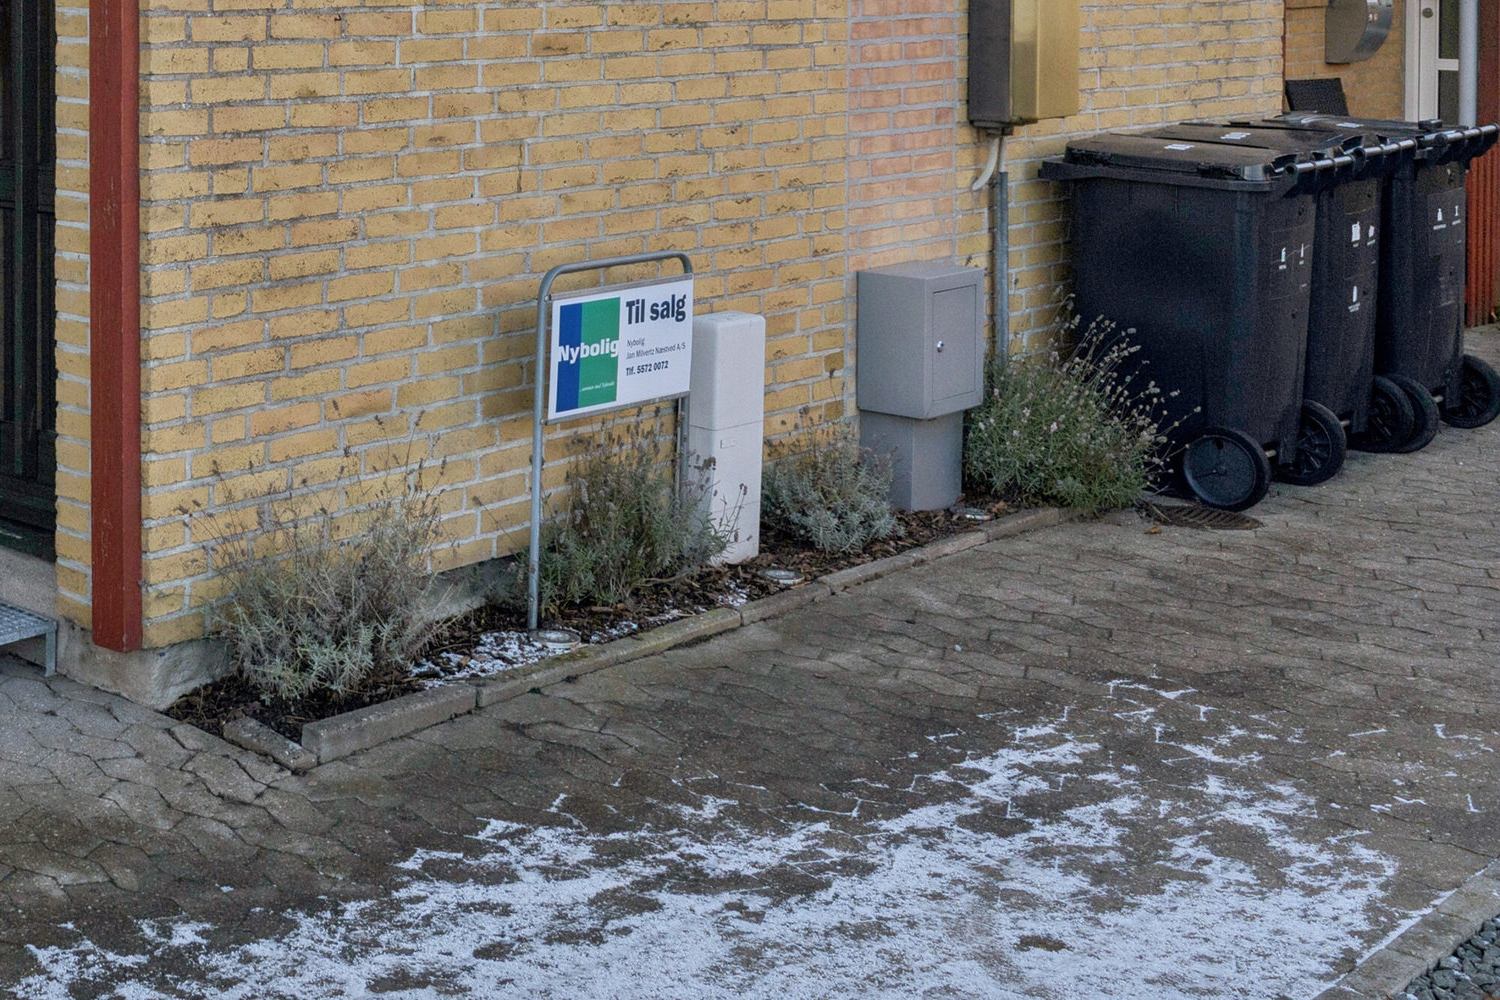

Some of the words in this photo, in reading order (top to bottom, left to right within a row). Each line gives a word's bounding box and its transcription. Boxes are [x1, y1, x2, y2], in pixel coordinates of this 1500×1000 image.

[626, 298, 645, 325] Til
[650, 294, 687, 323] salg
[558, 338, 620, 365] Nybolig
[627, 337, 646, 348] Nybolig
[626, 366, 636, 376] Tlf.
[637, 363, 652, 374] 5572
[653, 360, 669, 371] 0072
